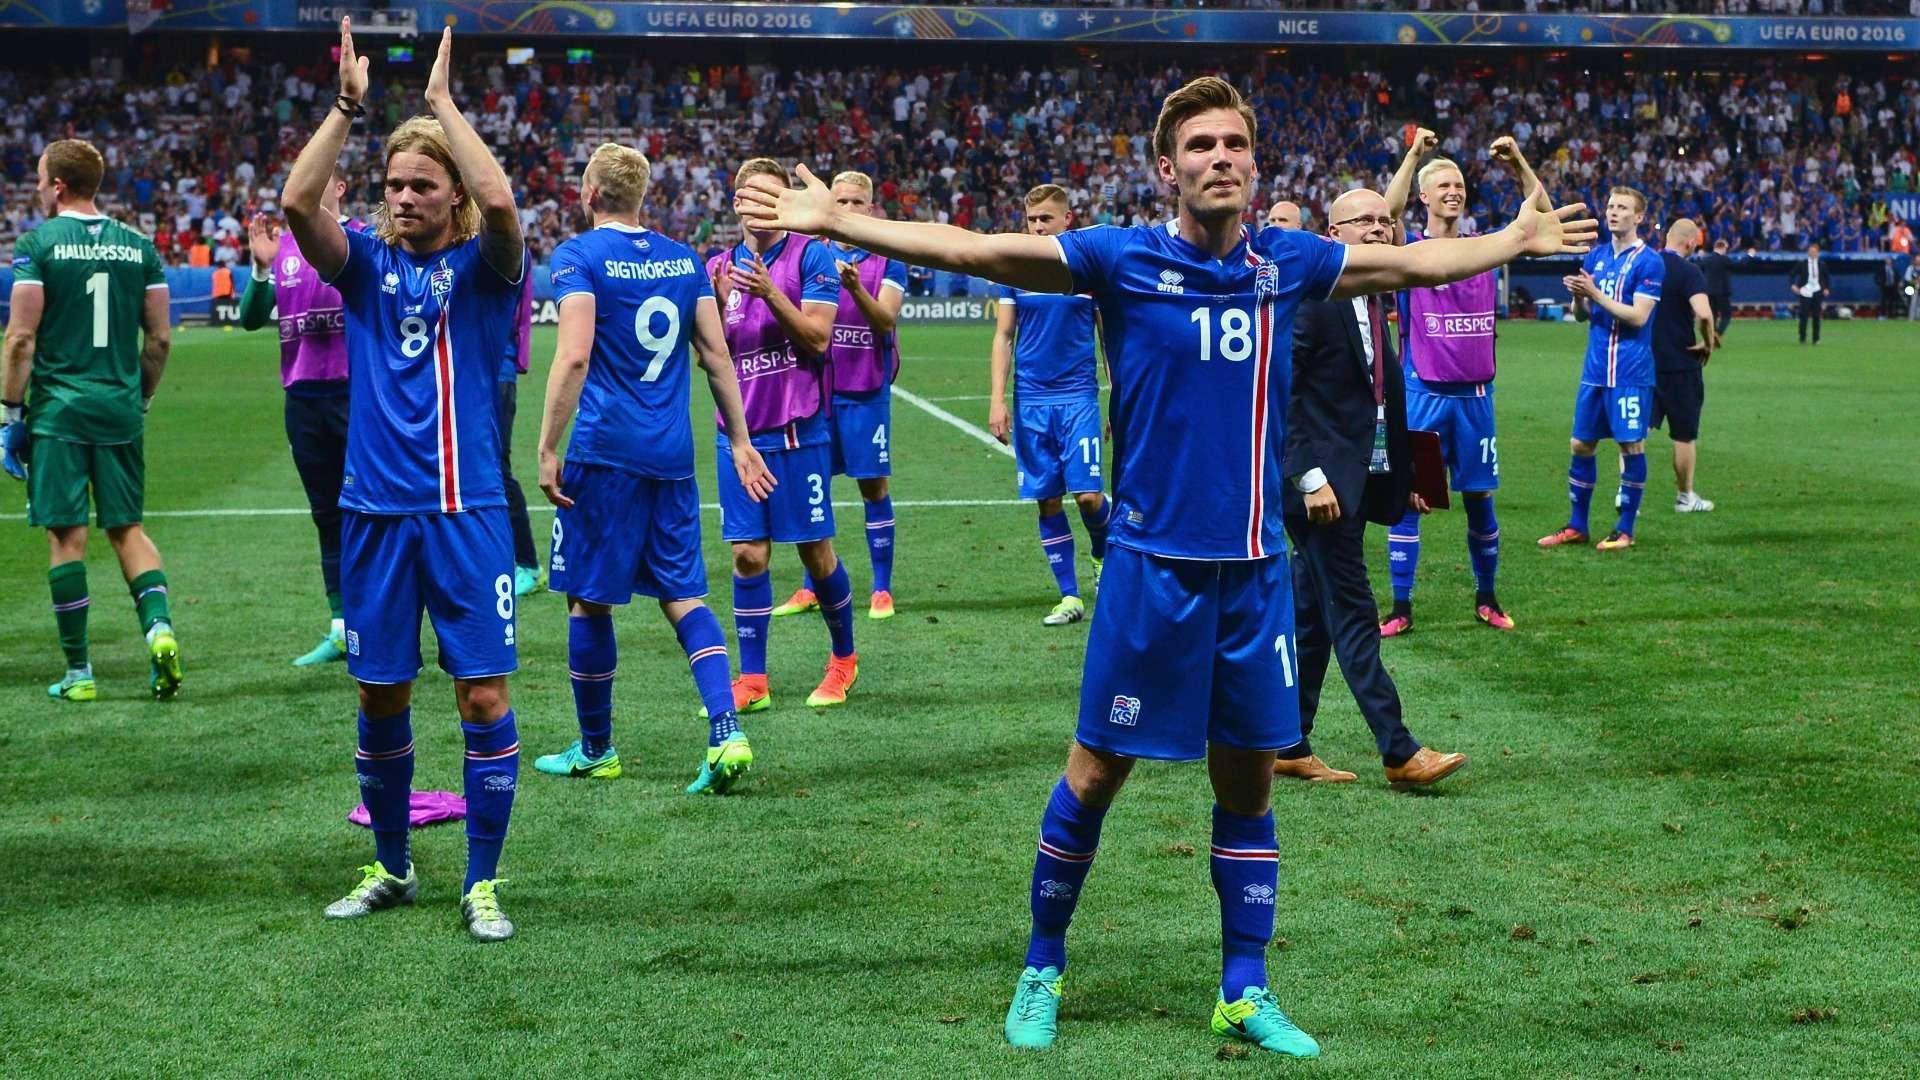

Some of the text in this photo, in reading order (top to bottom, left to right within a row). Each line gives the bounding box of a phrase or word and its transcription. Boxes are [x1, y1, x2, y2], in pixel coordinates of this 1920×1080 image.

[647, 12, 812, 28] UEFA EURO 2016
[1279, 20, 1318, 34] NICE
[1760, 25, 1905, 41] UEFA EURO 2016
[1891, 199, 1920, 220] NI
[604, 258, 696, 280] SIGTHÓRSSON
[1599, 279, 1615, 298] 15
[86, 272, 109, 348] 1
[899, 302, 982, 319] onald's
[1191, 307, 1253, 361] 18
[1445, 316, 1494, 333] RESPEC
[400, 316, 429, 357] 8
[635, 296, 680, 382] 9
[834, 329, 873, 345] SPEC
[1618, 397, 1640, 419] 15
[872, 424, 887, 449] 4
[1079, 437, 1100, 463] 11
[808, 473, 824, 505] 3
[552, 517, 563, 552] 9
[495, 574, 513, 620] 8
[1274, 632, 1298, 687] 1
